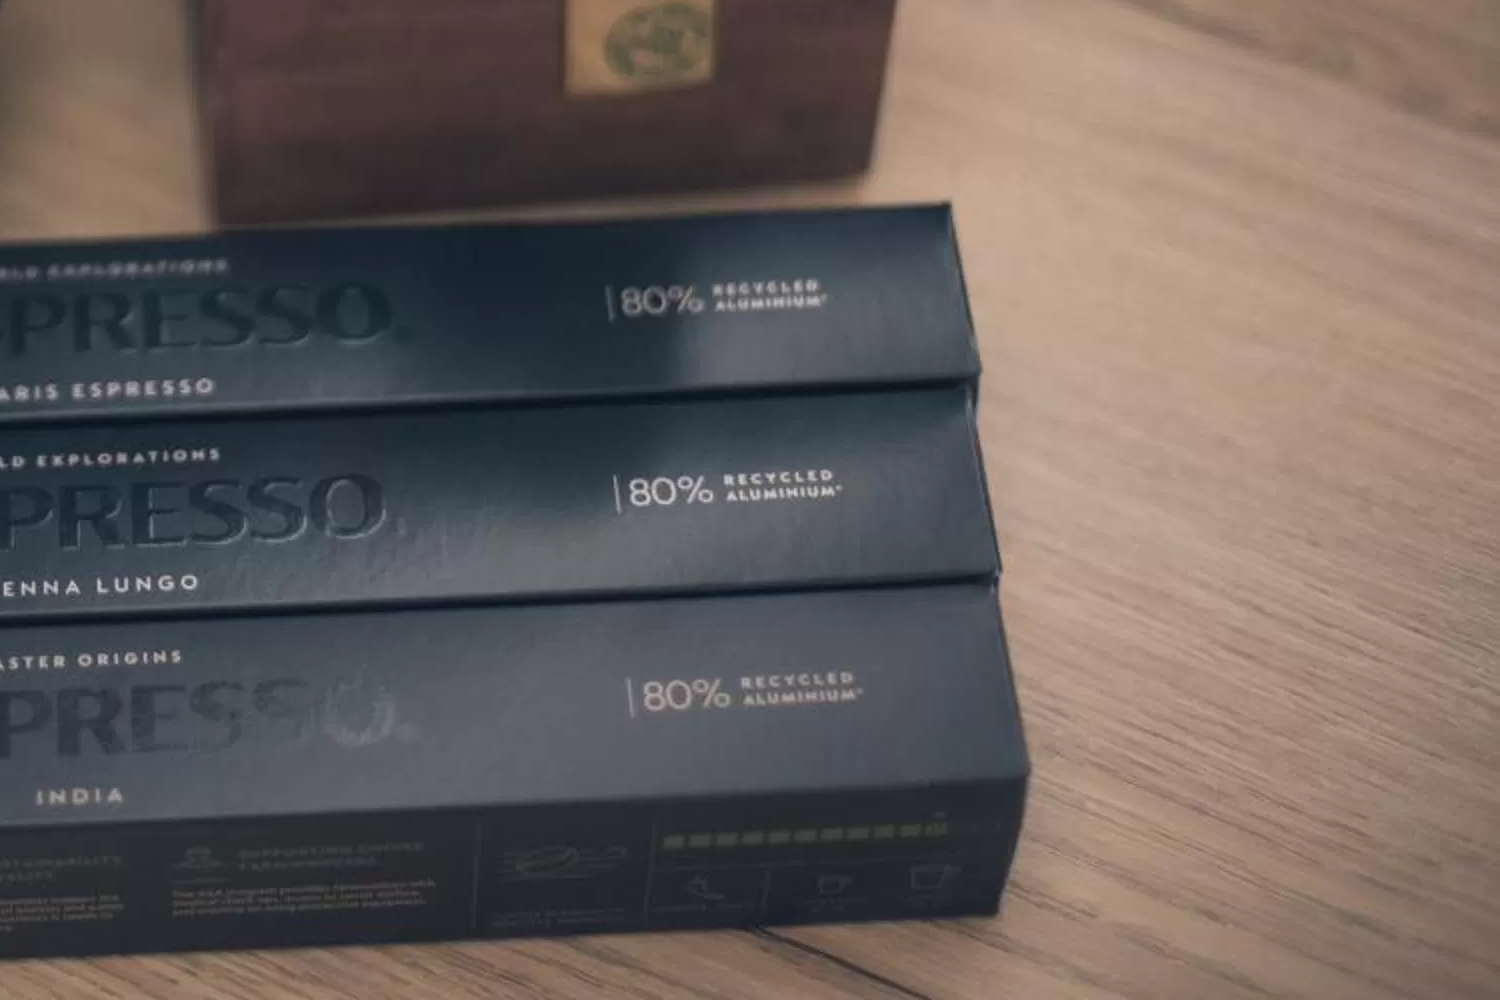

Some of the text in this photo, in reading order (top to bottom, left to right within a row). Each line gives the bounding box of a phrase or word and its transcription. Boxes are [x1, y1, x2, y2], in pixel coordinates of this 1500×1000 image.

[620, 285, 704, 316] 80%
[71, 377, 216, 400] ESPRESSO
[36, 448, 220, 469] EXPLORATIONS
[723, 469, 833, 486] RECYCLED
[628, 476, 713, 506] 80%
[96, 574, 199, 594] LUNGO
[77, 649, 183, 667] ORIGINS
[740, 671, 854, 689] RECYCLED
[643, 678, 731, 711] 80%
[36, 788, 124, 805] INDIA
